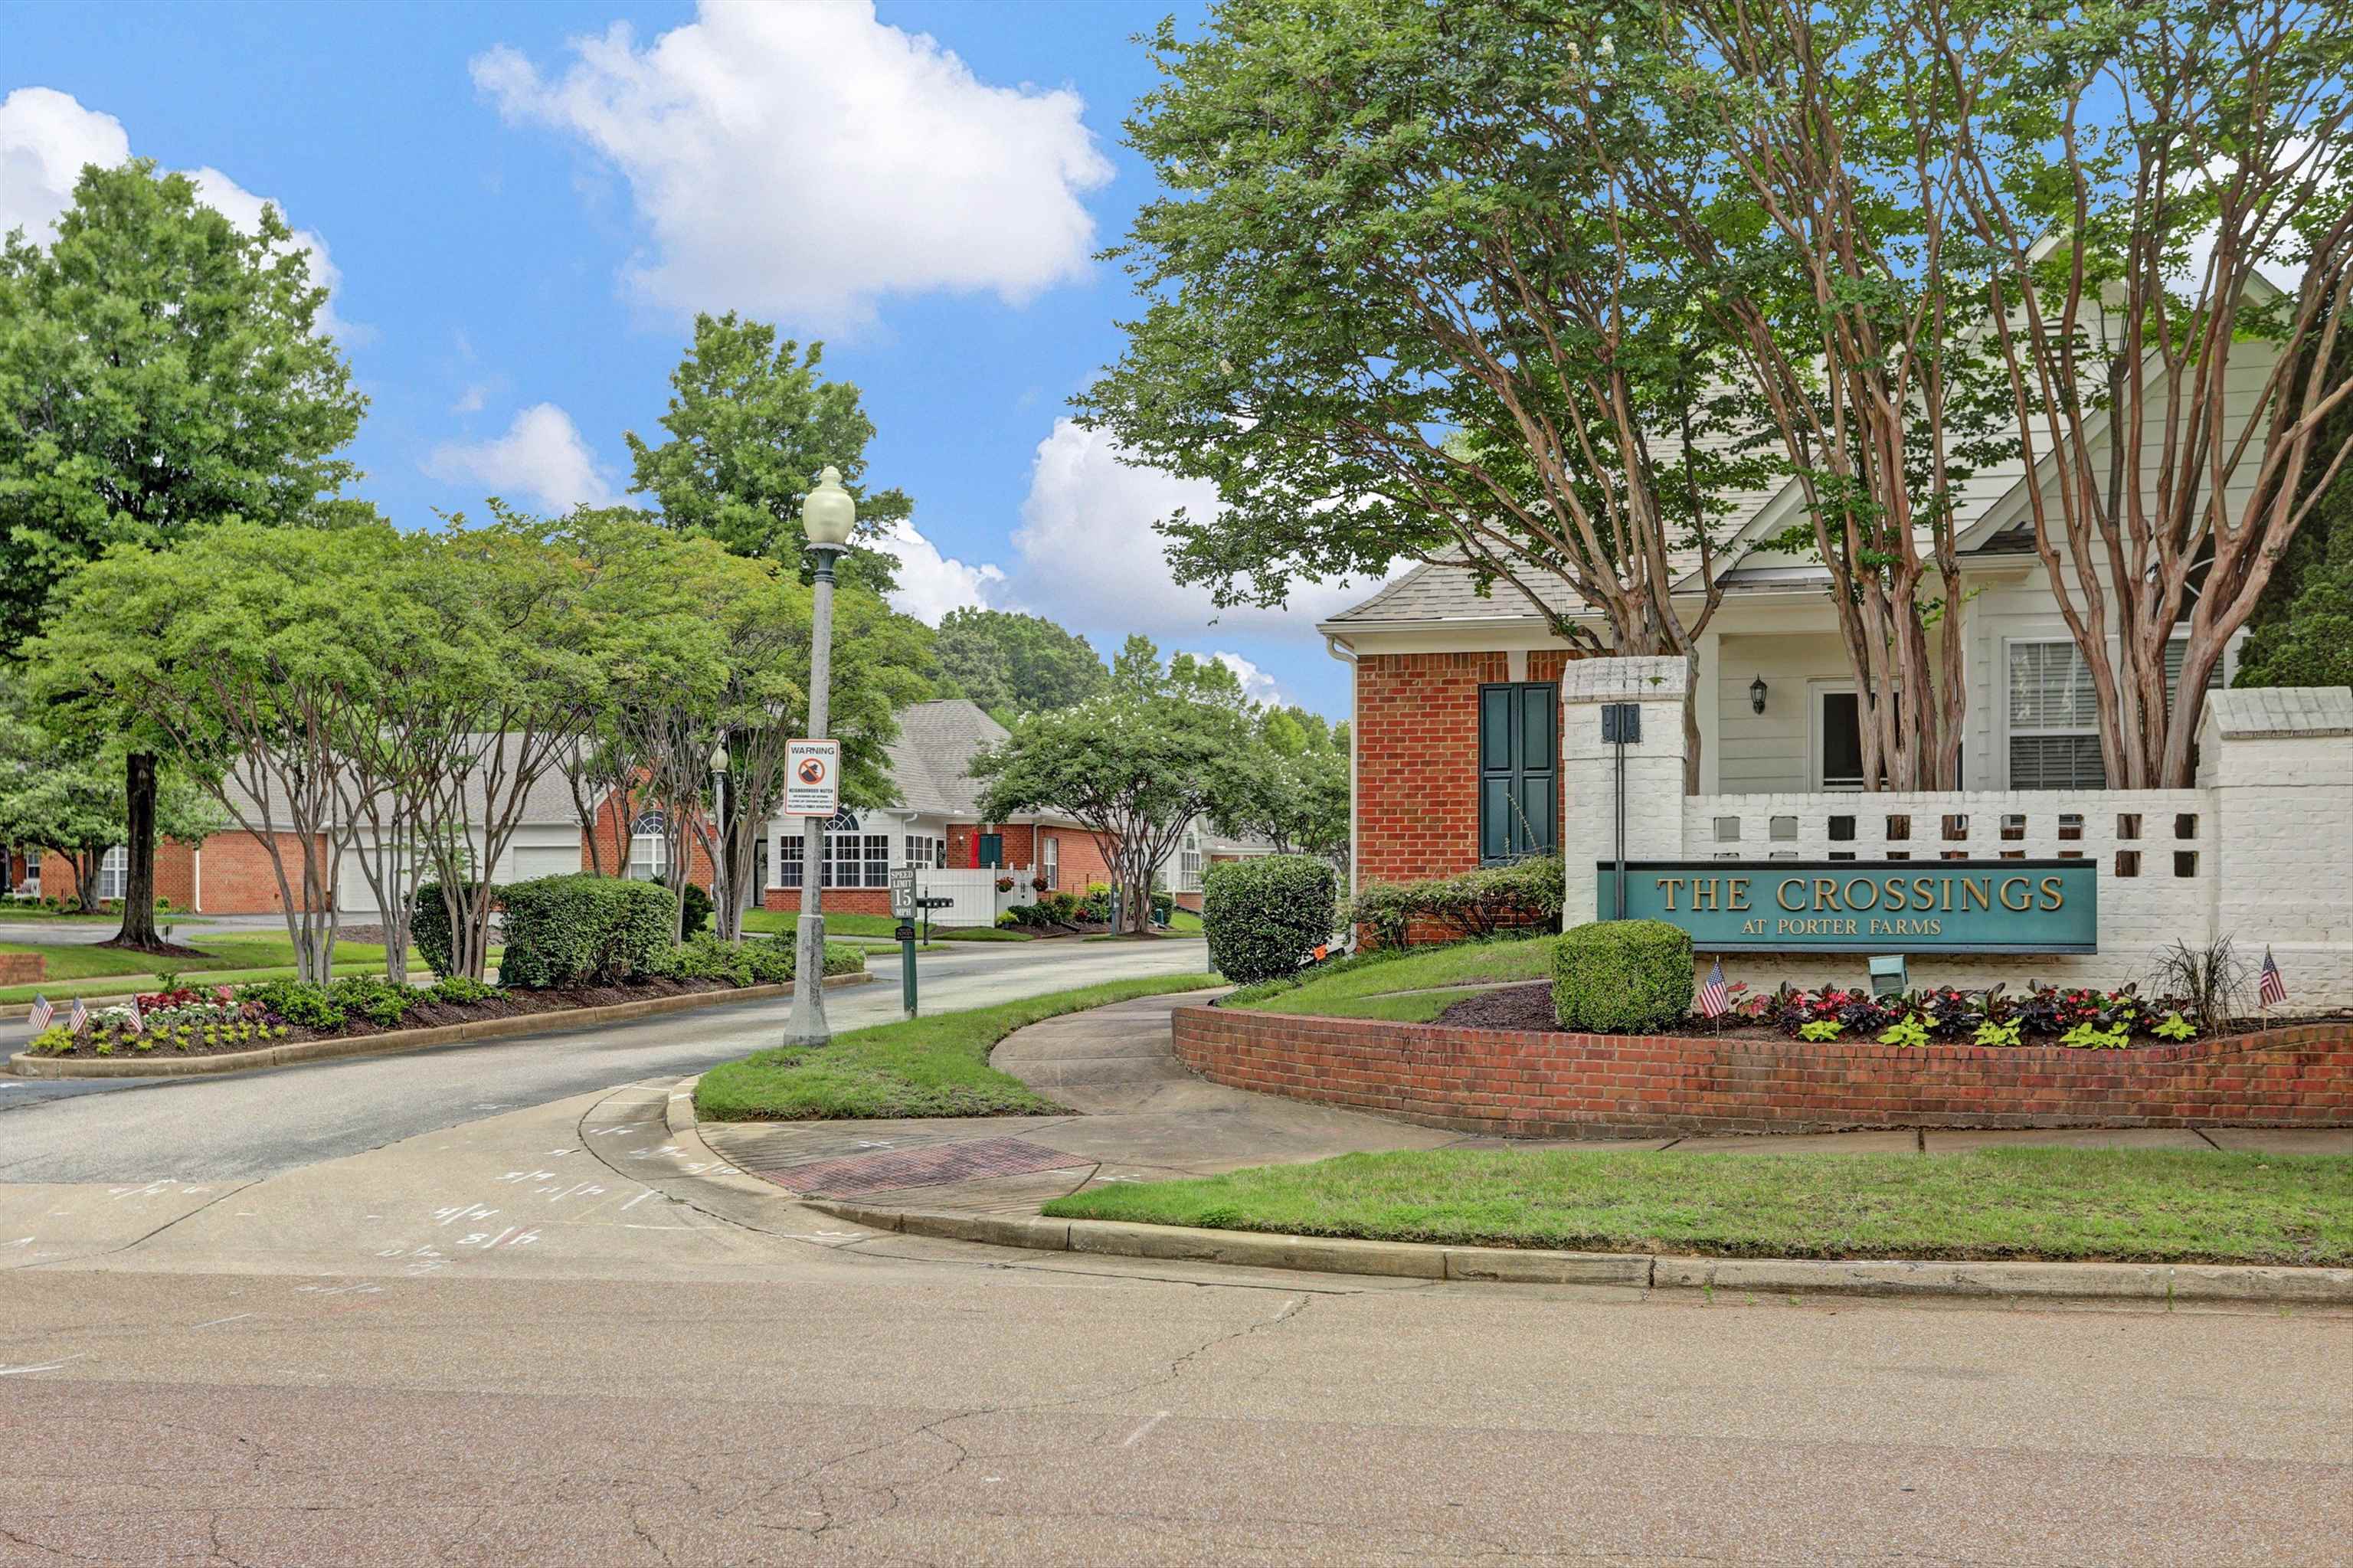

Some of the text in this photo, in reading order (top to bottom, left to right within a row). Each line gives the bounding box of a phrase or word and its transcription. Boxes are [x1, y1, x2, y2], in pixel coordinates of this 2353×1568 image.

[891, 870, 913, 879] SPEED
[893, 879, 912, 888] LIMIT
[895, 889, 911, 906] 15
[1656, 877, 2063, 911] THE CROSSINGS
[895, 908, 911, 916] MPH
[1741, 919, 1942, 935] AT PORTER FARMS
